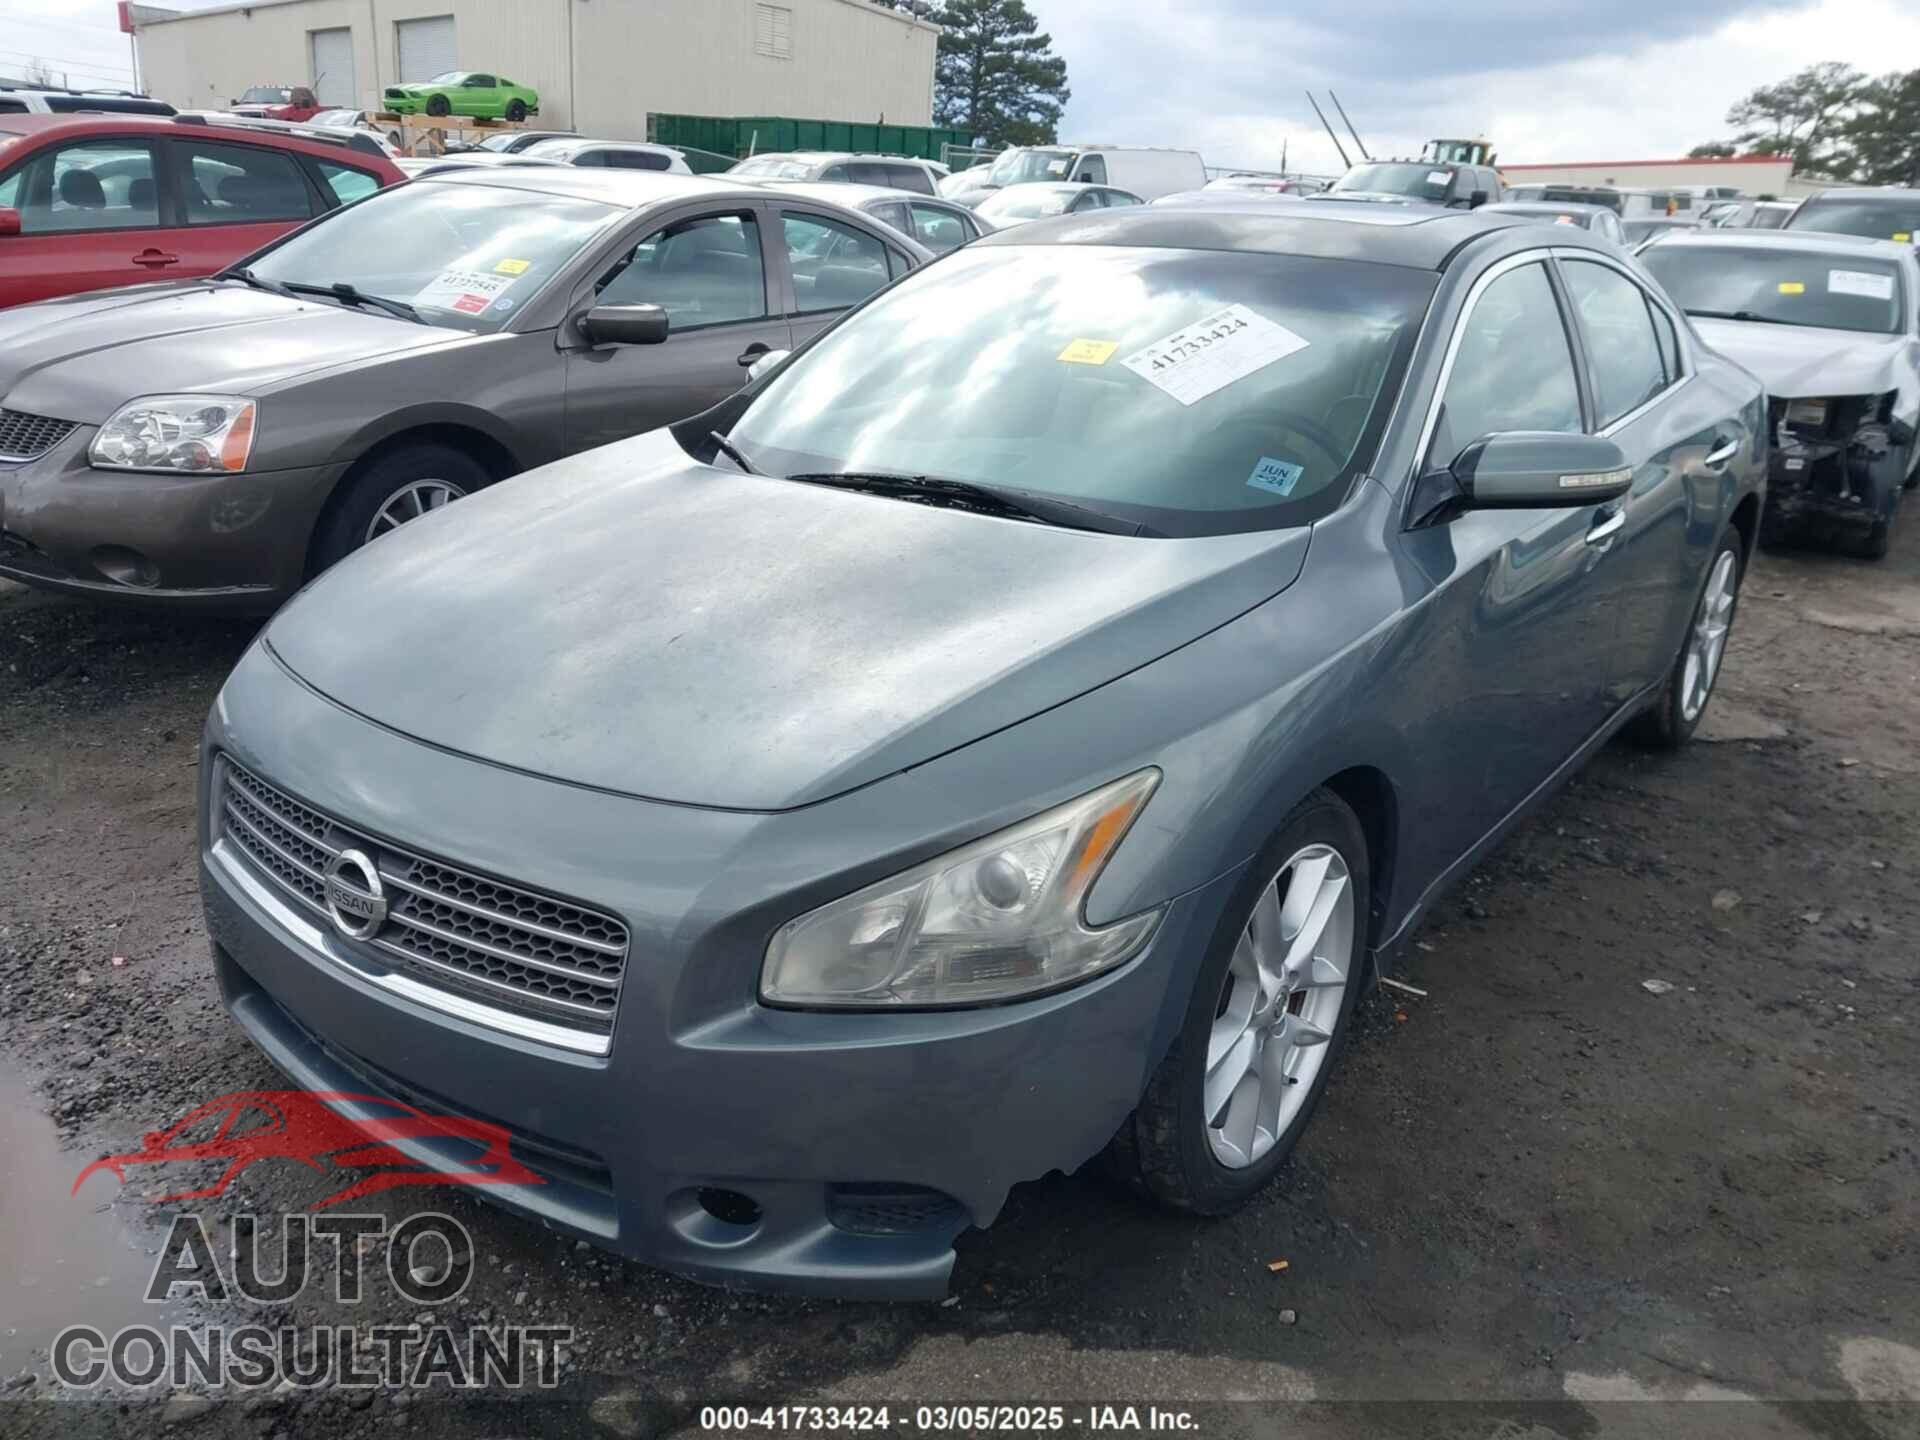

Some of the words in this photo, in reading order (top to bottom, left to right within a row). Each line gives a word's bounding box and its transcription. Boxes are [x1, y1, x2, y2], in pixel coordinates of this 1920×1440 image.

[1151, 317, 1249, 372] 41733424
[1262, 464, 1288, 478] JUN
[325, 886, 374, 914] NISSAN
